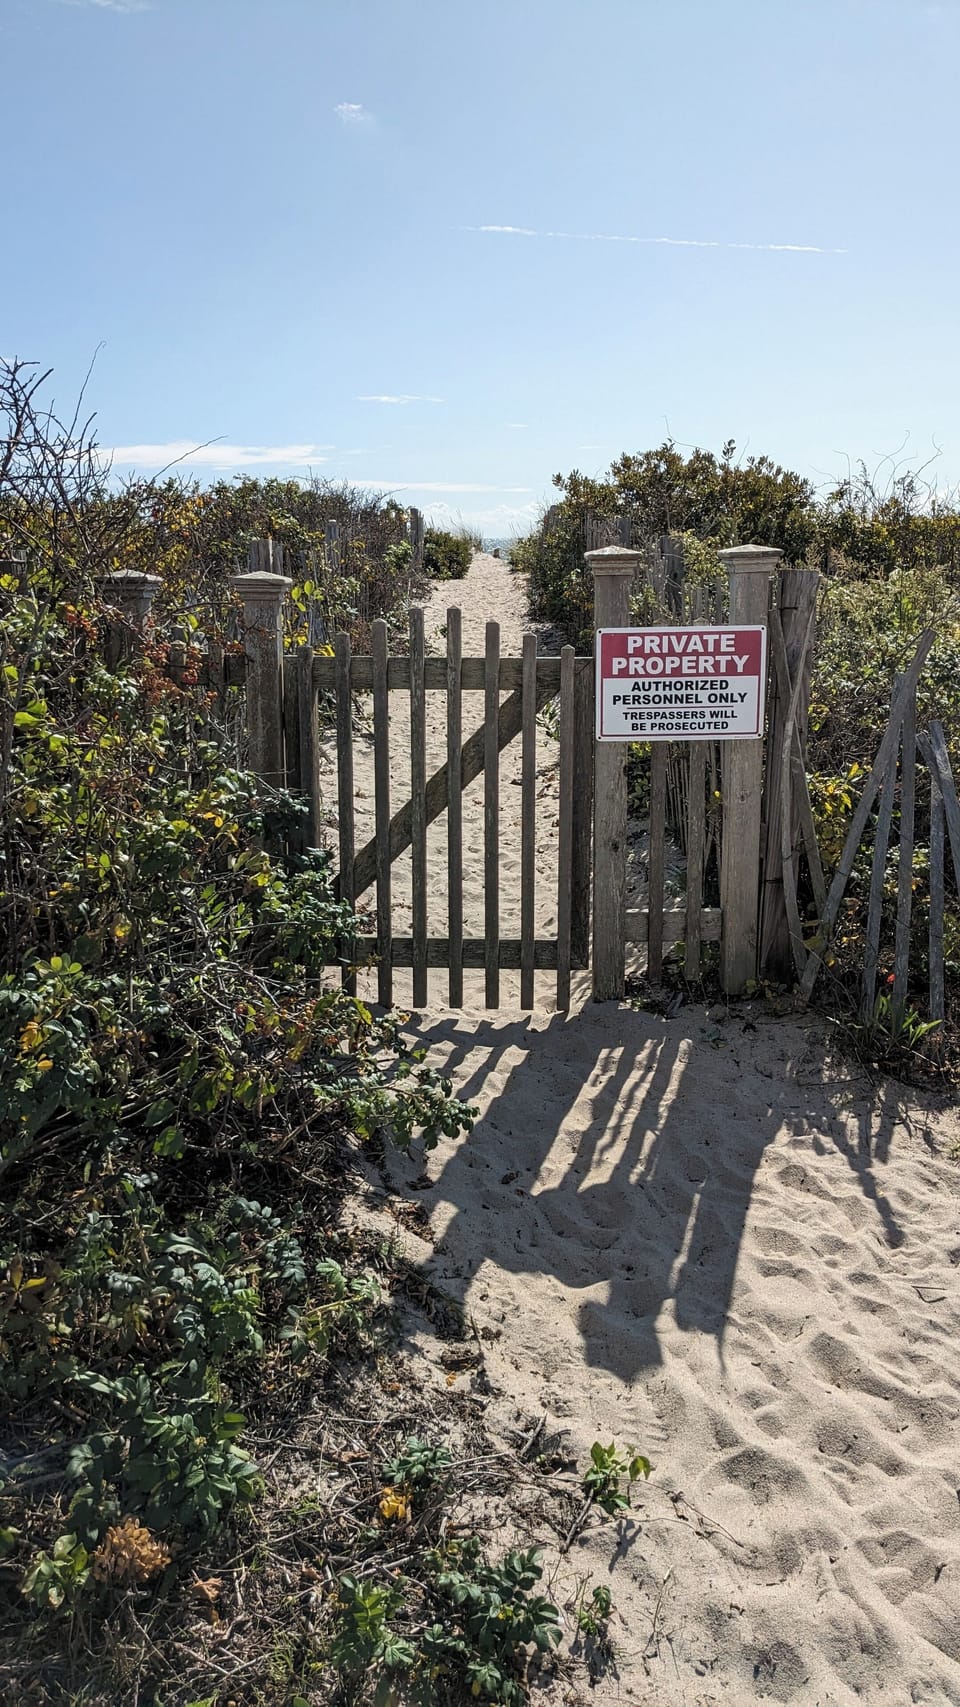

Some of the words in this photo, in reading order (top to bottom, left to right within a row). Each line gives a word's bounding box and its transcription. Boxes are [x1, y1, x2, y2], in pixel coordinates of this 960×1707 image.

[627, 634, 736, 654] PRIVATE
[611, 655, 750, 675] PROPERTY
[631, 679, 729, 692] AUTHORIZED
[612, 693, 703, 705] PERSONNEL
[707, 692, 748, 703] ONLY
[622, 710, 706, 720] TRESPASSERS
[709, 710, 738, 719] WILL
[631, 722, 647, 731] BE
[650, 721, 729, 731] PROSECUTED
